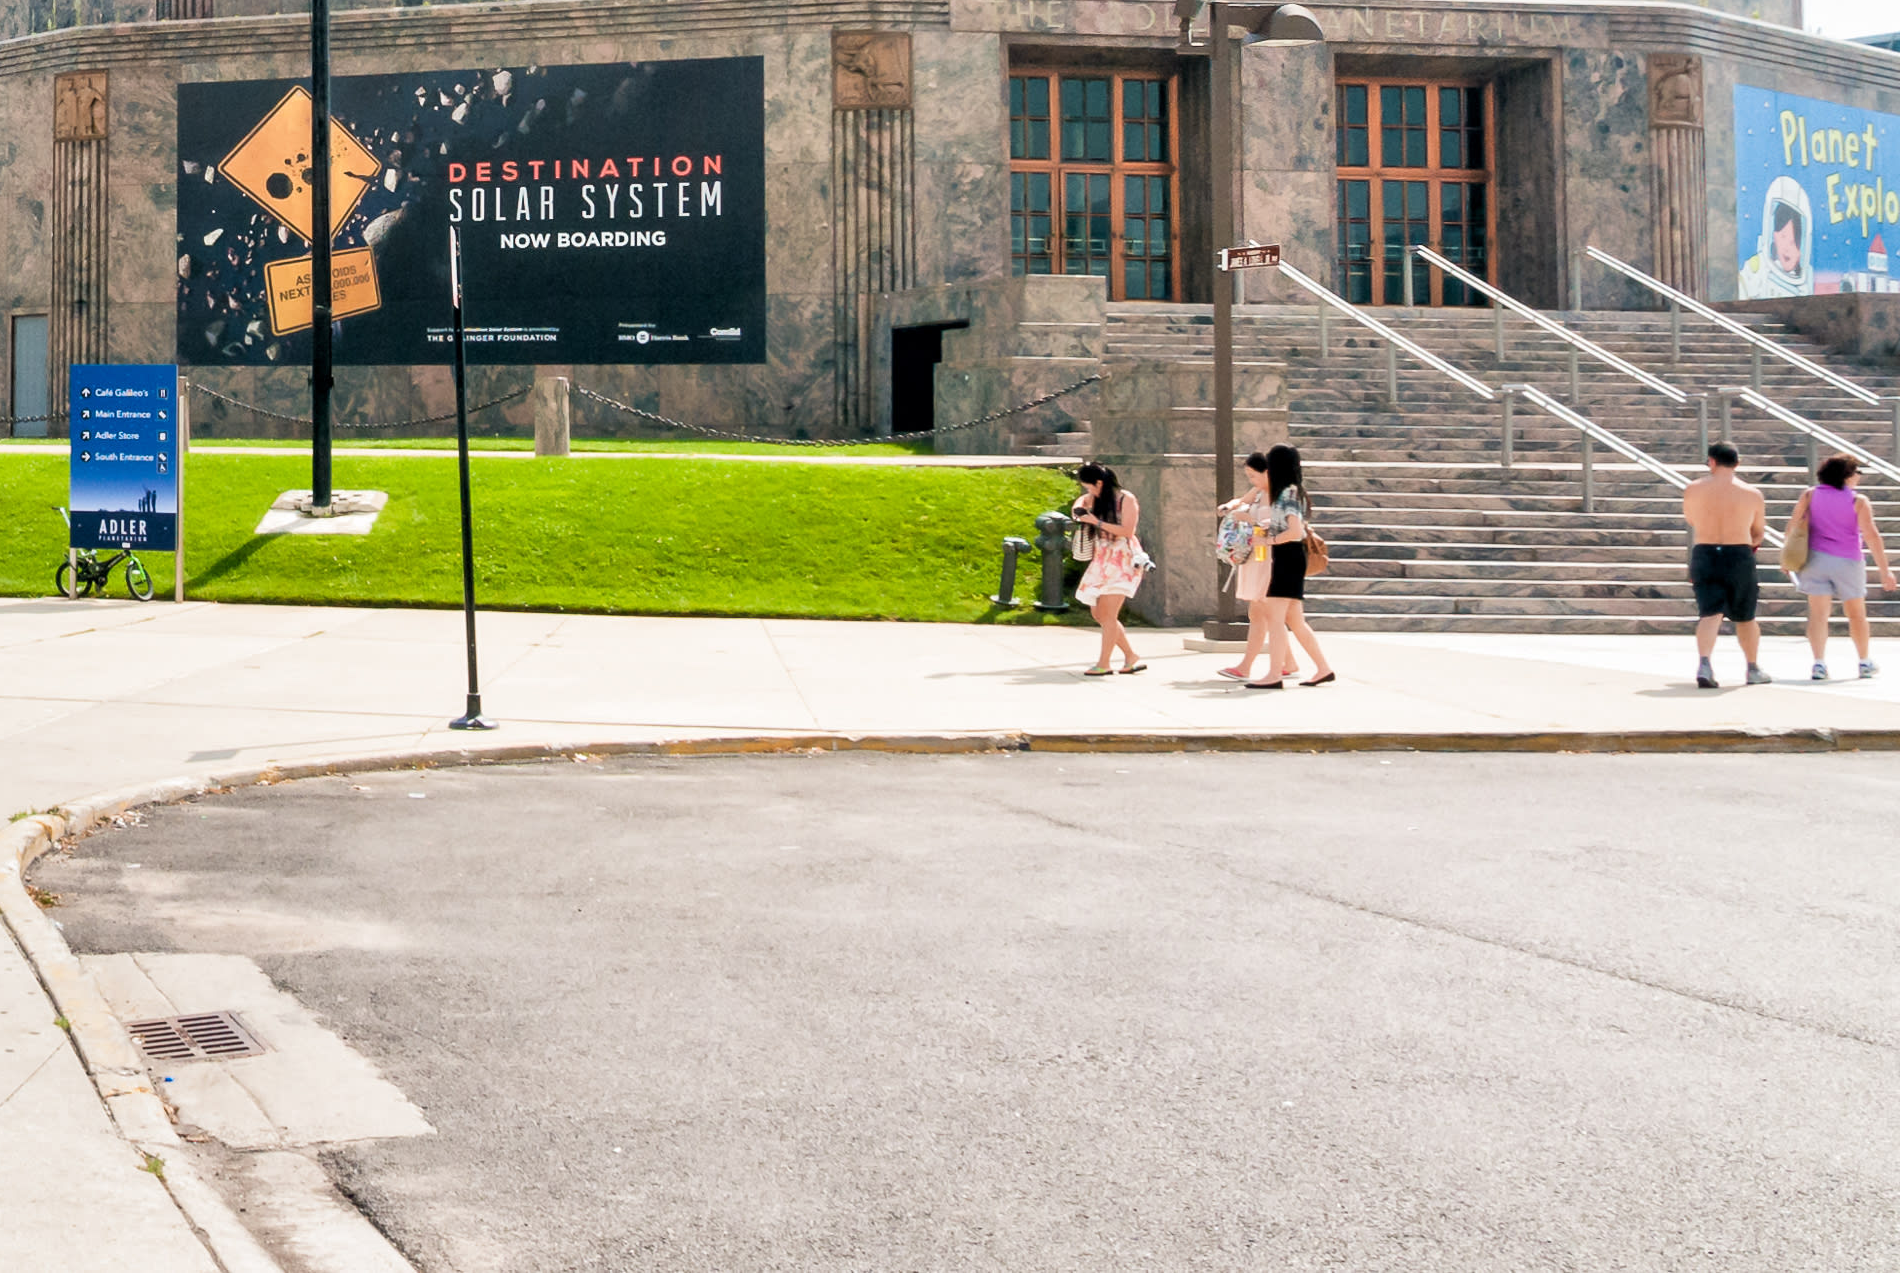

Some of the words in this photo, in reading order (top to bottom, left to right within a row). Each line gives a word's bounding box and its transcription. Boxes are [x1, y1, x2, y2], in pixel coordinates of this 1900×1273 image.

[1321, 6, 1575, 40] ANETARIUM
[1780, 109, 1878, 171] Planet
[448, 155, 722, 183] DESTINATION
[449, 185, 555, 222] SOLAR
[581, 180, 722, 219] SYSTEM
[500, 233, 551, 249] NOW
[557, 230, 667, 248] BOARDING
[295, 266, 357, 286] ASOIDS
[279, 286, 311, 303] NEXT
[427, 334, 444, 342] THE
[95, 388, 114, 397] Café
[95, 409, 115, 418] Main
[116, 409, 152, 419] Entrance
[95, 431, 117, 440] Adler
[118, 431, 140, 440] Store
[95, 452, 118, 461] South
[119, 452, 155, 462] Entrance
[99, 518, 147, 536] ADLER
